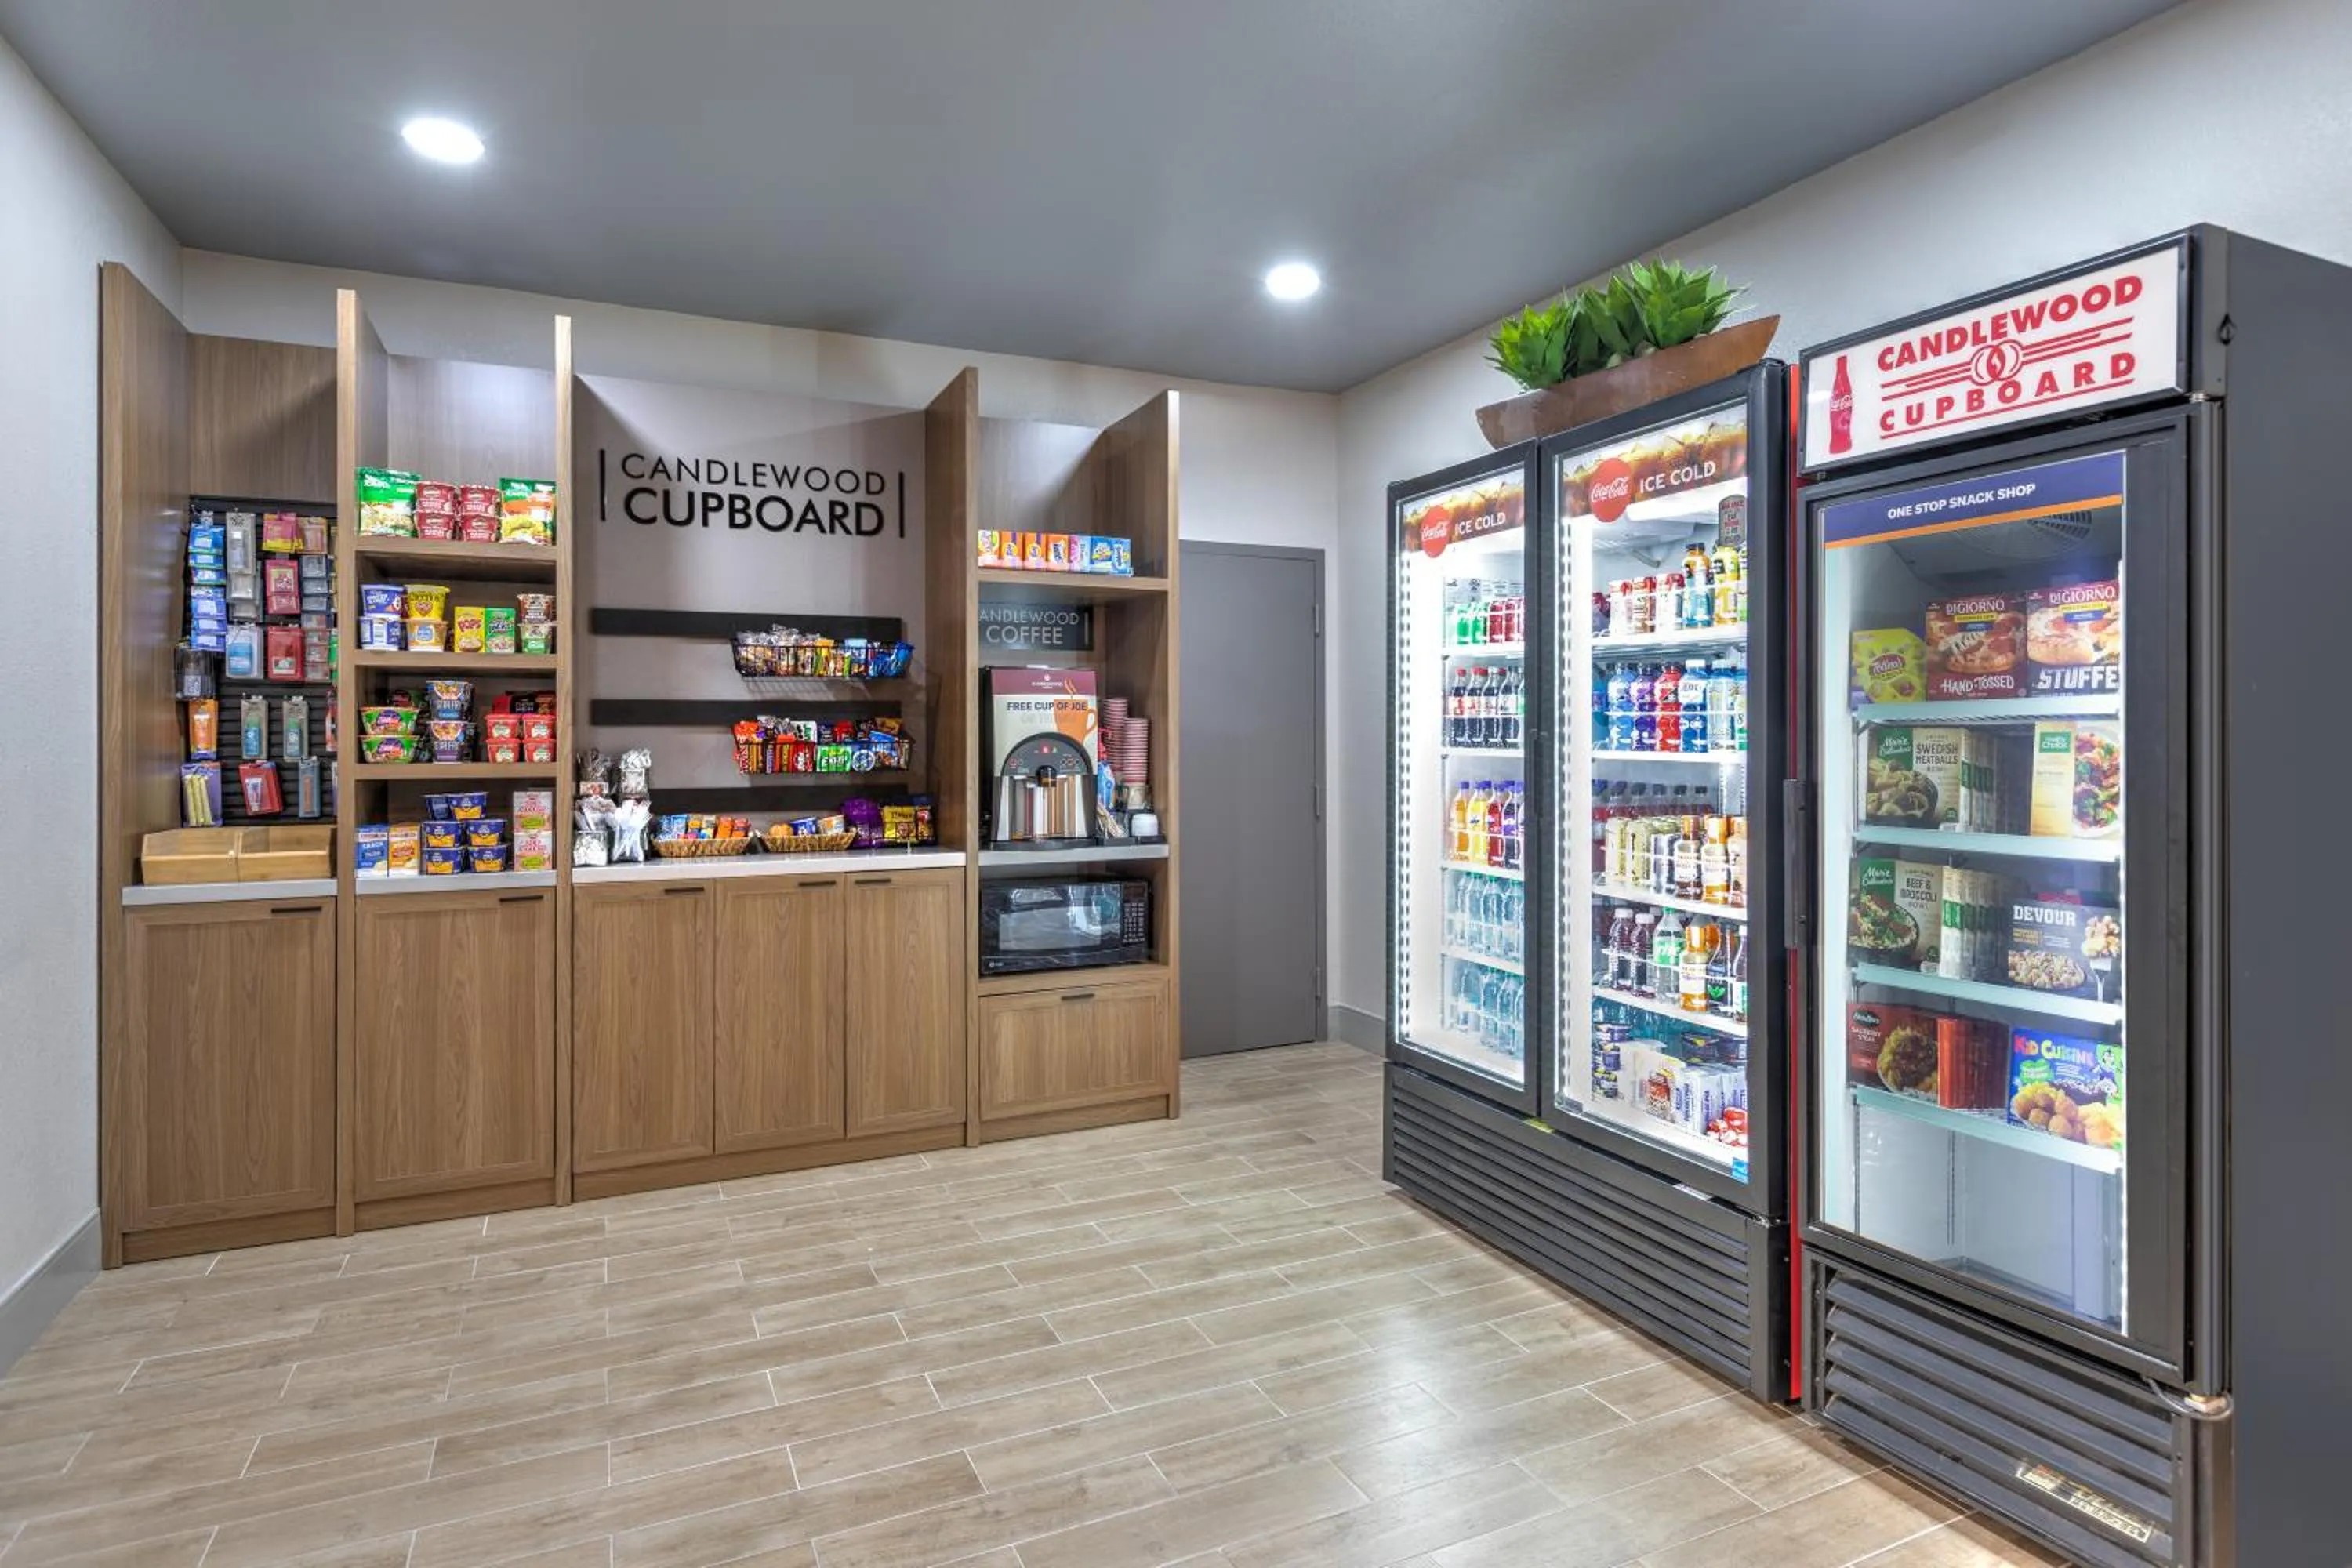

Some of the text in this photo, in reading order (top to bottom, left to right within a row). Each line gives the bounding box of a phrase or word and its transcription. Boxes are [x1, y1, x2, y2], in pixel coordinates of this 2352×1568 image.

[1878, 275, 2143, 372] CANDLEWOOD
[1879, 352, 2136, 432] CUPBOARD
[621, 453, 885, 495] CANDLEWOOD
[1640, 460, 1716, 494] ICE COLD
[623, 488, 885, 537] CUPBOARD
[1887, 483, 2036, 520] ONE STOP SNACK SHOP
[1454, 511, 1506, 536] ICE COLD
[985, 625, 1064, 645] COFFEE
[1006, 702, 1088, 711] FREE CUP OF JOE
[1915, 742, 1958, 755] SWEDISH
[1915, 755, 1958, 764] MEATBALLS
[2012, 905, 2077, 927] DEVOUR
